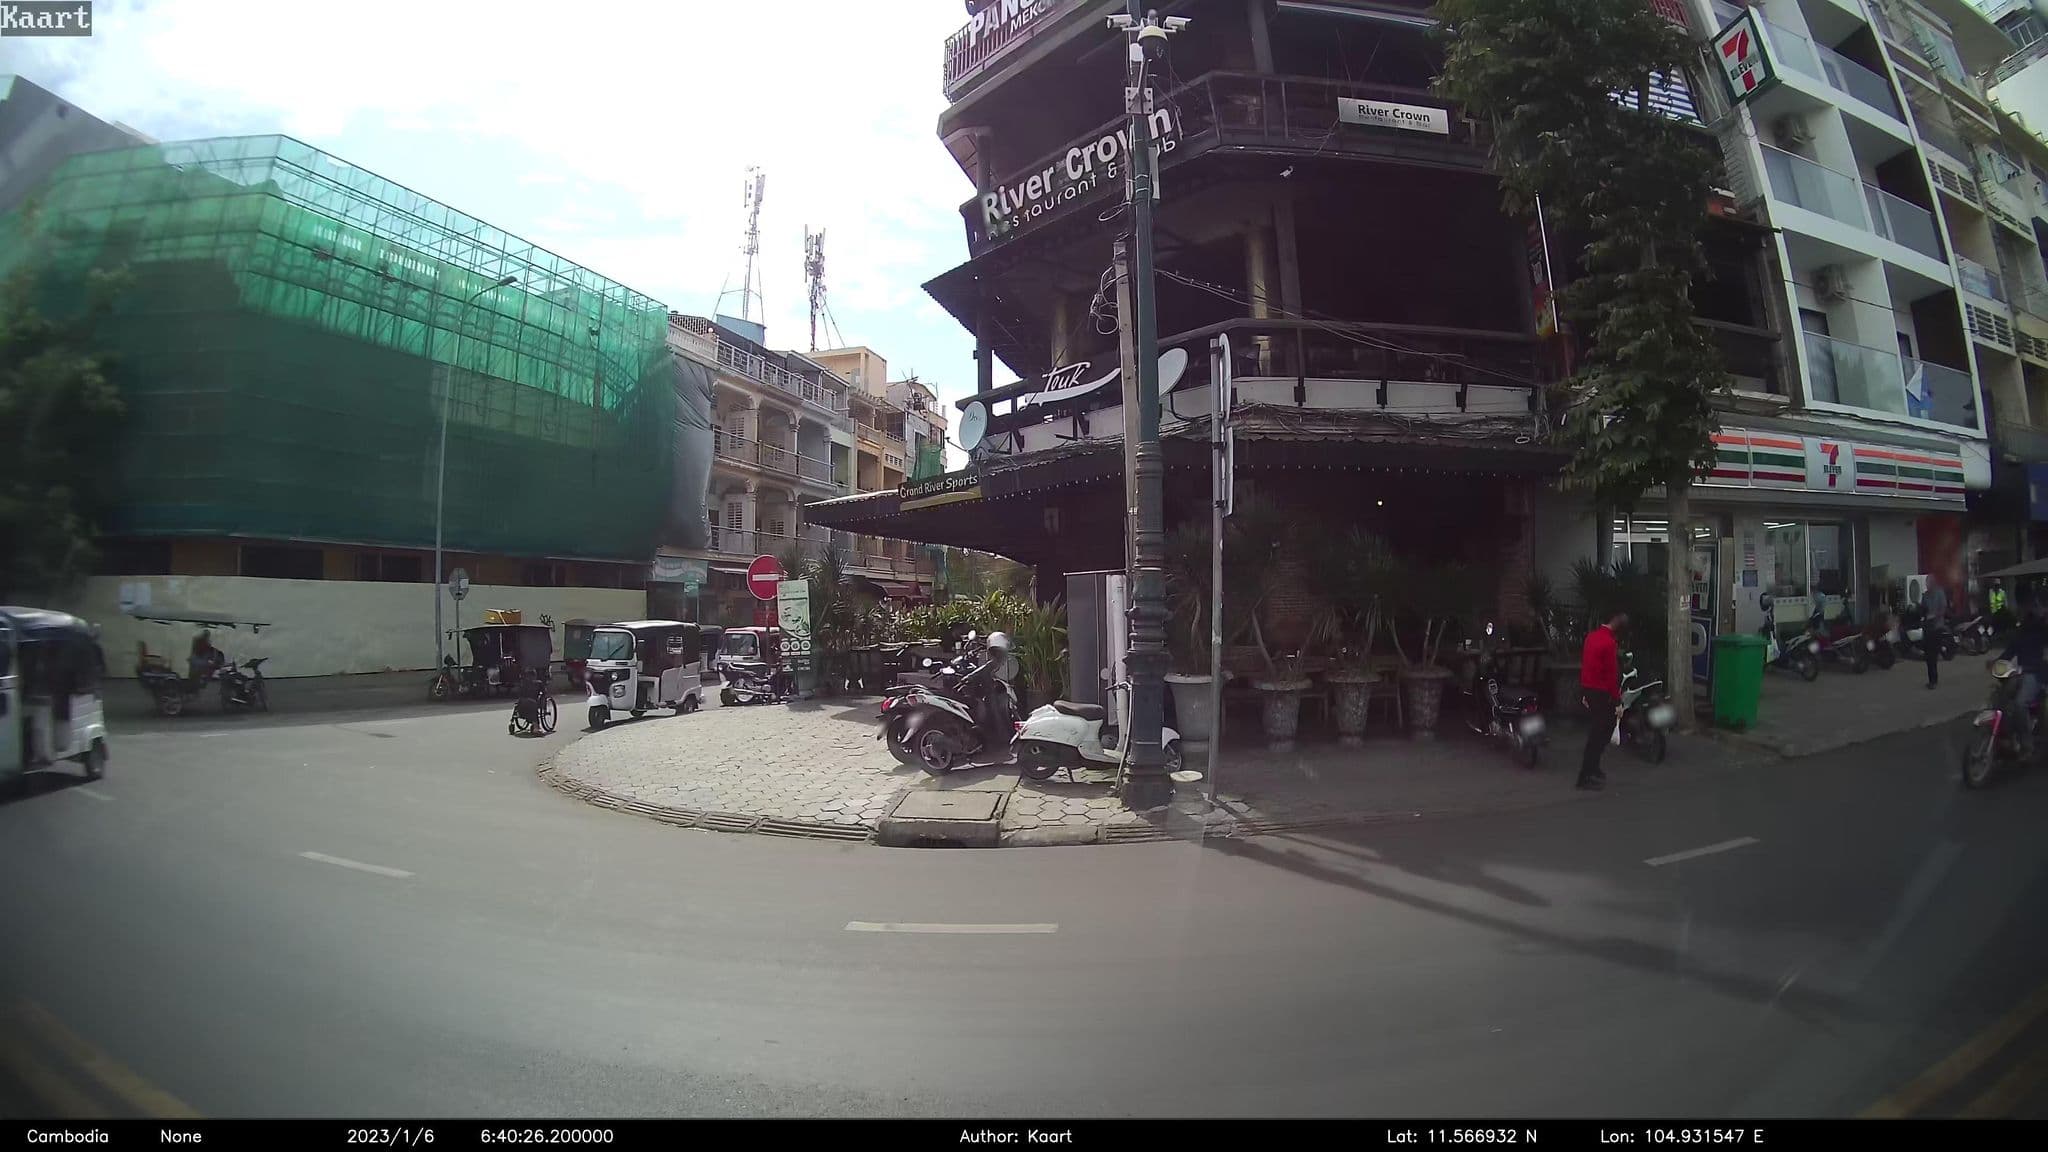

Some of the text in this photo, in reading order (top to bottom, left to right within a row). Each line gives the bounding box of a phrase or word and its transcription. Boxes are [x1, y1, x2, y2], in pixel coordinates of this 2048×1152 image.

[1358, 104, 1389, 117] River
[1392, 108, 1430, 122] Crown
[983, 166, 1055, 224] River
[988, 172, 1097, 241] staurant
[900, 474, 978, 498] Grand River Sports
[1820, 443, 1839, 488] 7
